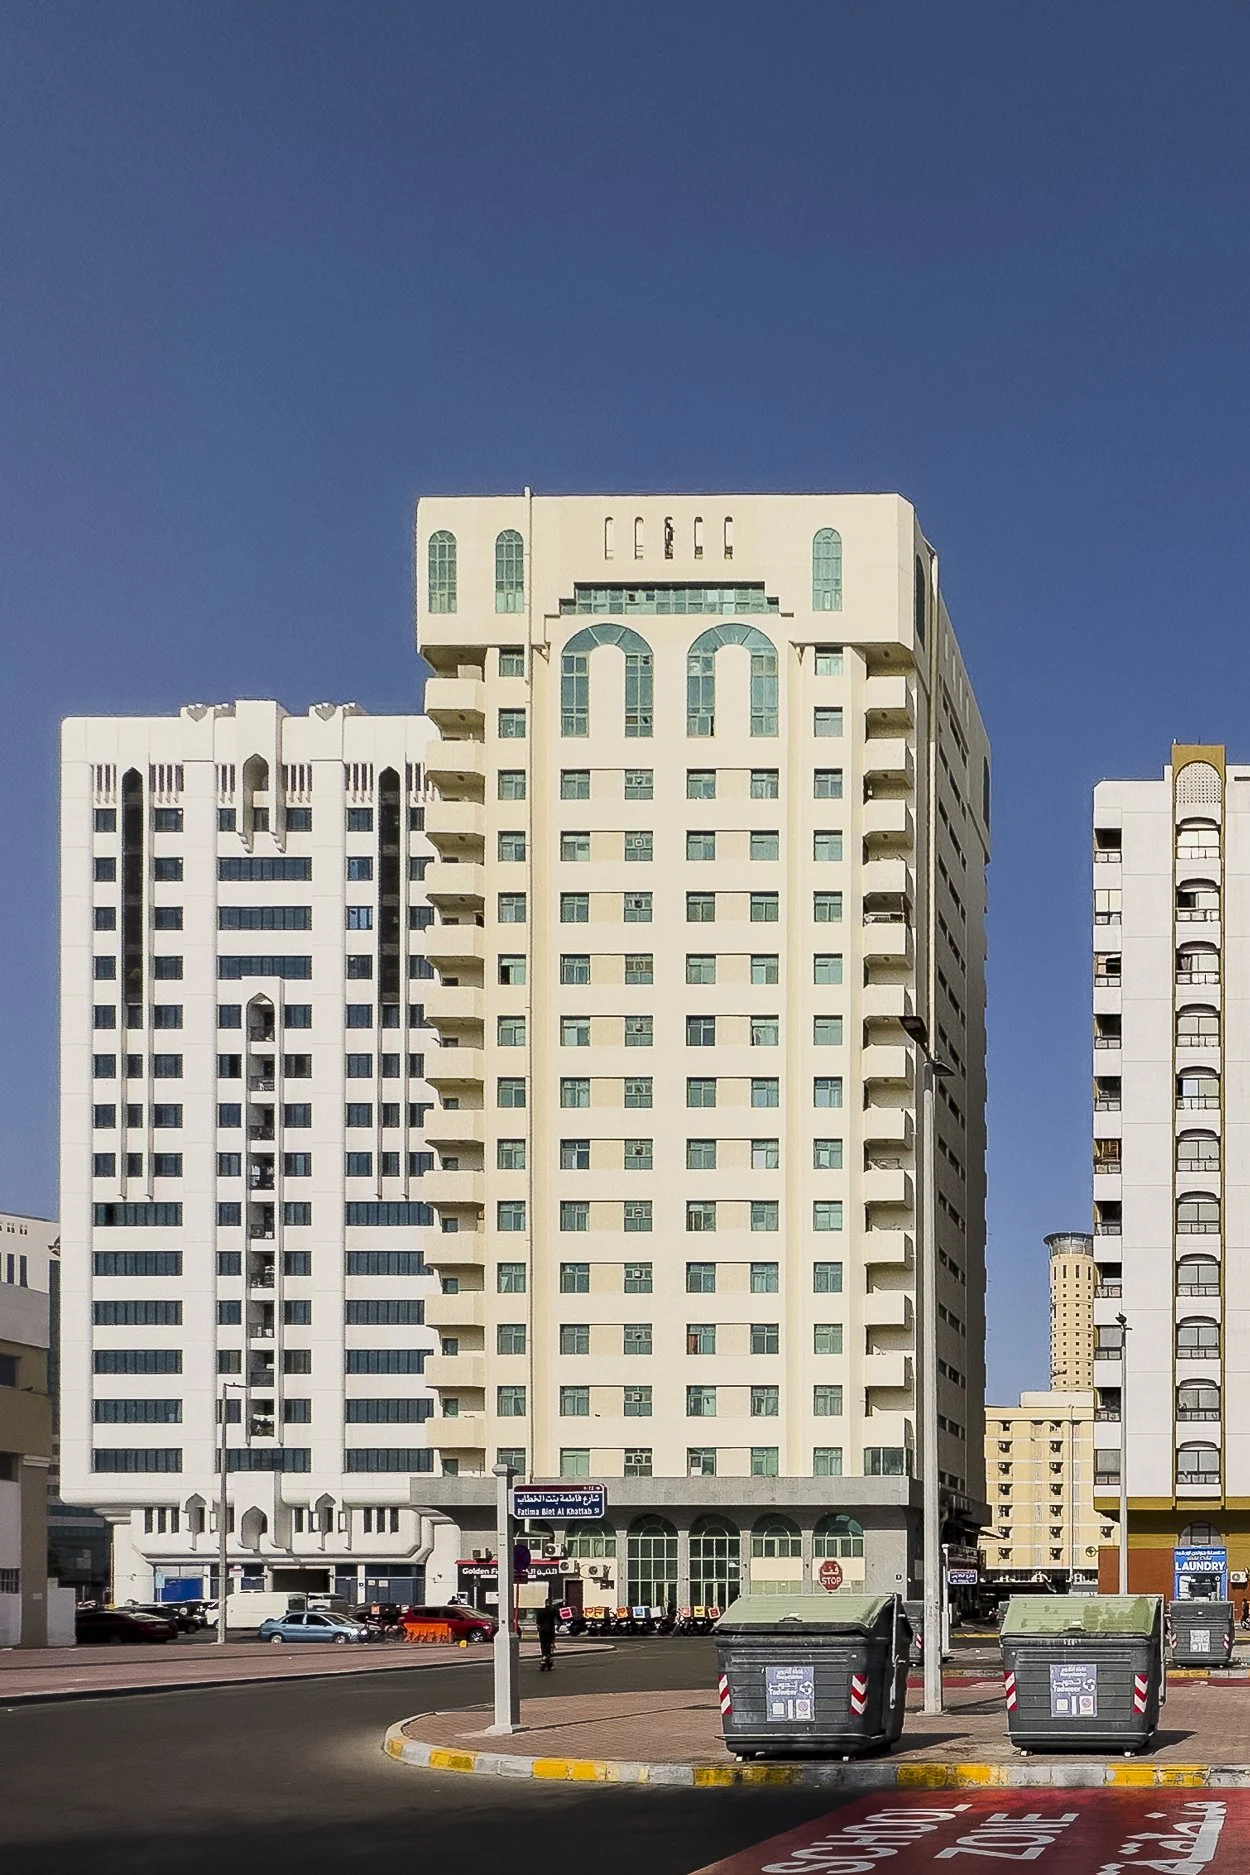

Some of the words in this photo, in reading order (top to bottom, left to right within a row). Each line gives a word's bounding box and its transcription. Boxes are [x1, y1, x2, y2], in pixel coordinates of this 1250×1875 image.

[517, 1494, 545, 1505] الخطاب
[545, 1495, 559, 1505] بنت
[560, 1494, 582, 1502] فاطمة
[583, 1494, 600, 1505] شارع
[517, 1508, 540, 1516] Fatima
[541, 1508, 555, 1516] Bint
[557, 1508, 564, 1516] Al
[566, 1508, 592, 1516] Khattab
[462, 1567, 490, 1575] Golden
[1175, 1561, 1226, 1571] LAUNDRY
[821, 1576, 842, 1586] STOP
[761, 1803, 973, 1874] SCHOOL
[934, 1813, 1080, 1861] ZONE
[1096, 1801, 1227, 1875] منطقة
